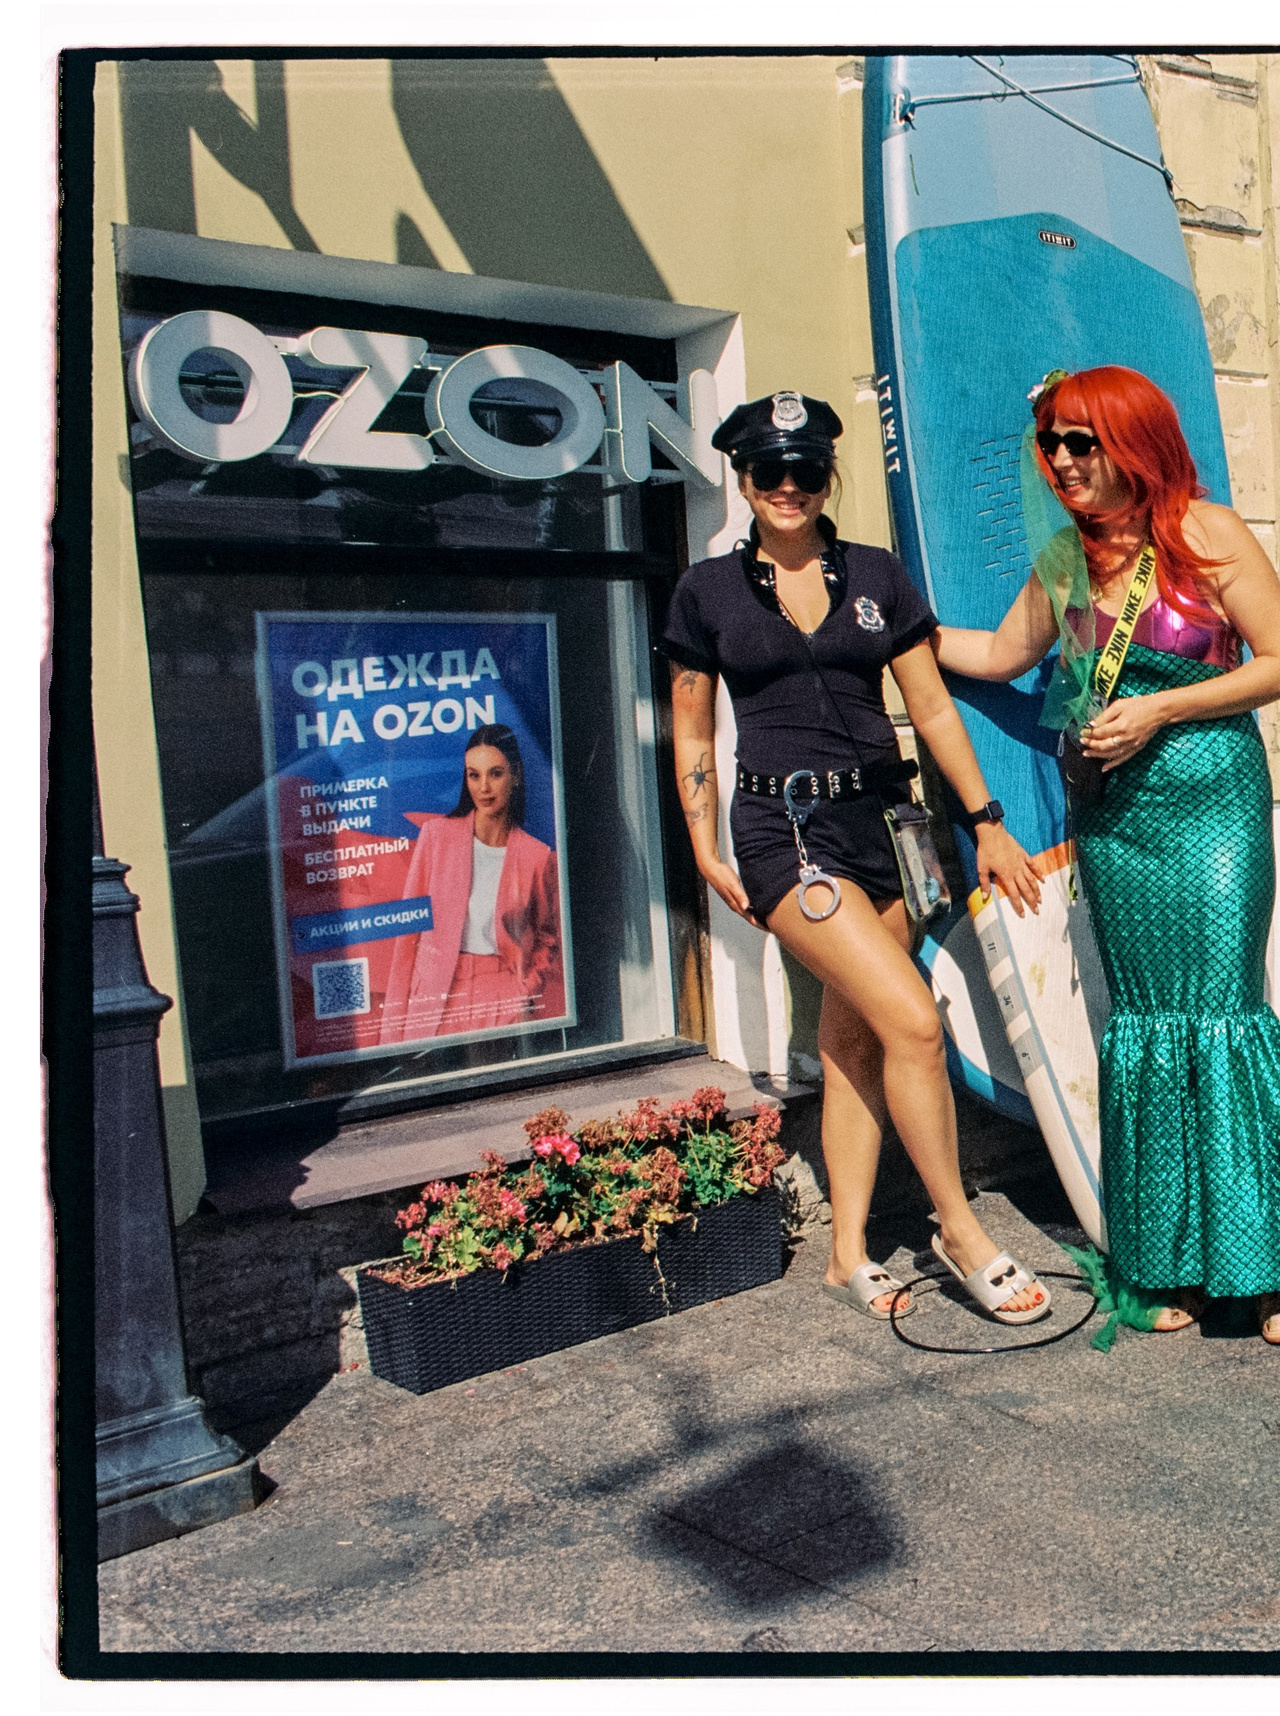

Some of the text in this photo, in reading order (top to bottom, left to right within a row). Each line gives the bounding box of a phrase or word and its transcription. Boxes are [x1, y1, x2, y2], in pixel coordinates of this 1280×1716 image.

[128, 310, 721, 486] OZON
[877, 374, 901, 473] ITIWIT
[1133, 551, 1155, 588] NIKE
[1120, 590, 1142, 627] NIKE
[1105, 628, 1129, 666] NIKE
[292, 648, 501, 702] ОДЕЖДА
[296, 695, 497, 749] НА OZON
[300, 776, 389, 799] ПРИМЕРКА
[301, 796, 378, 818] В ПУНКТЕ
[303, 815, 372, 836] ВЫДАЧИ
[304, 836, 410, 867] БЕСПЛАТНЫЙ
[306, 862, 375, 885] ВОЗВРАТ
[310, 908, 430, 939] АКЦИИ И СКИДКИ
